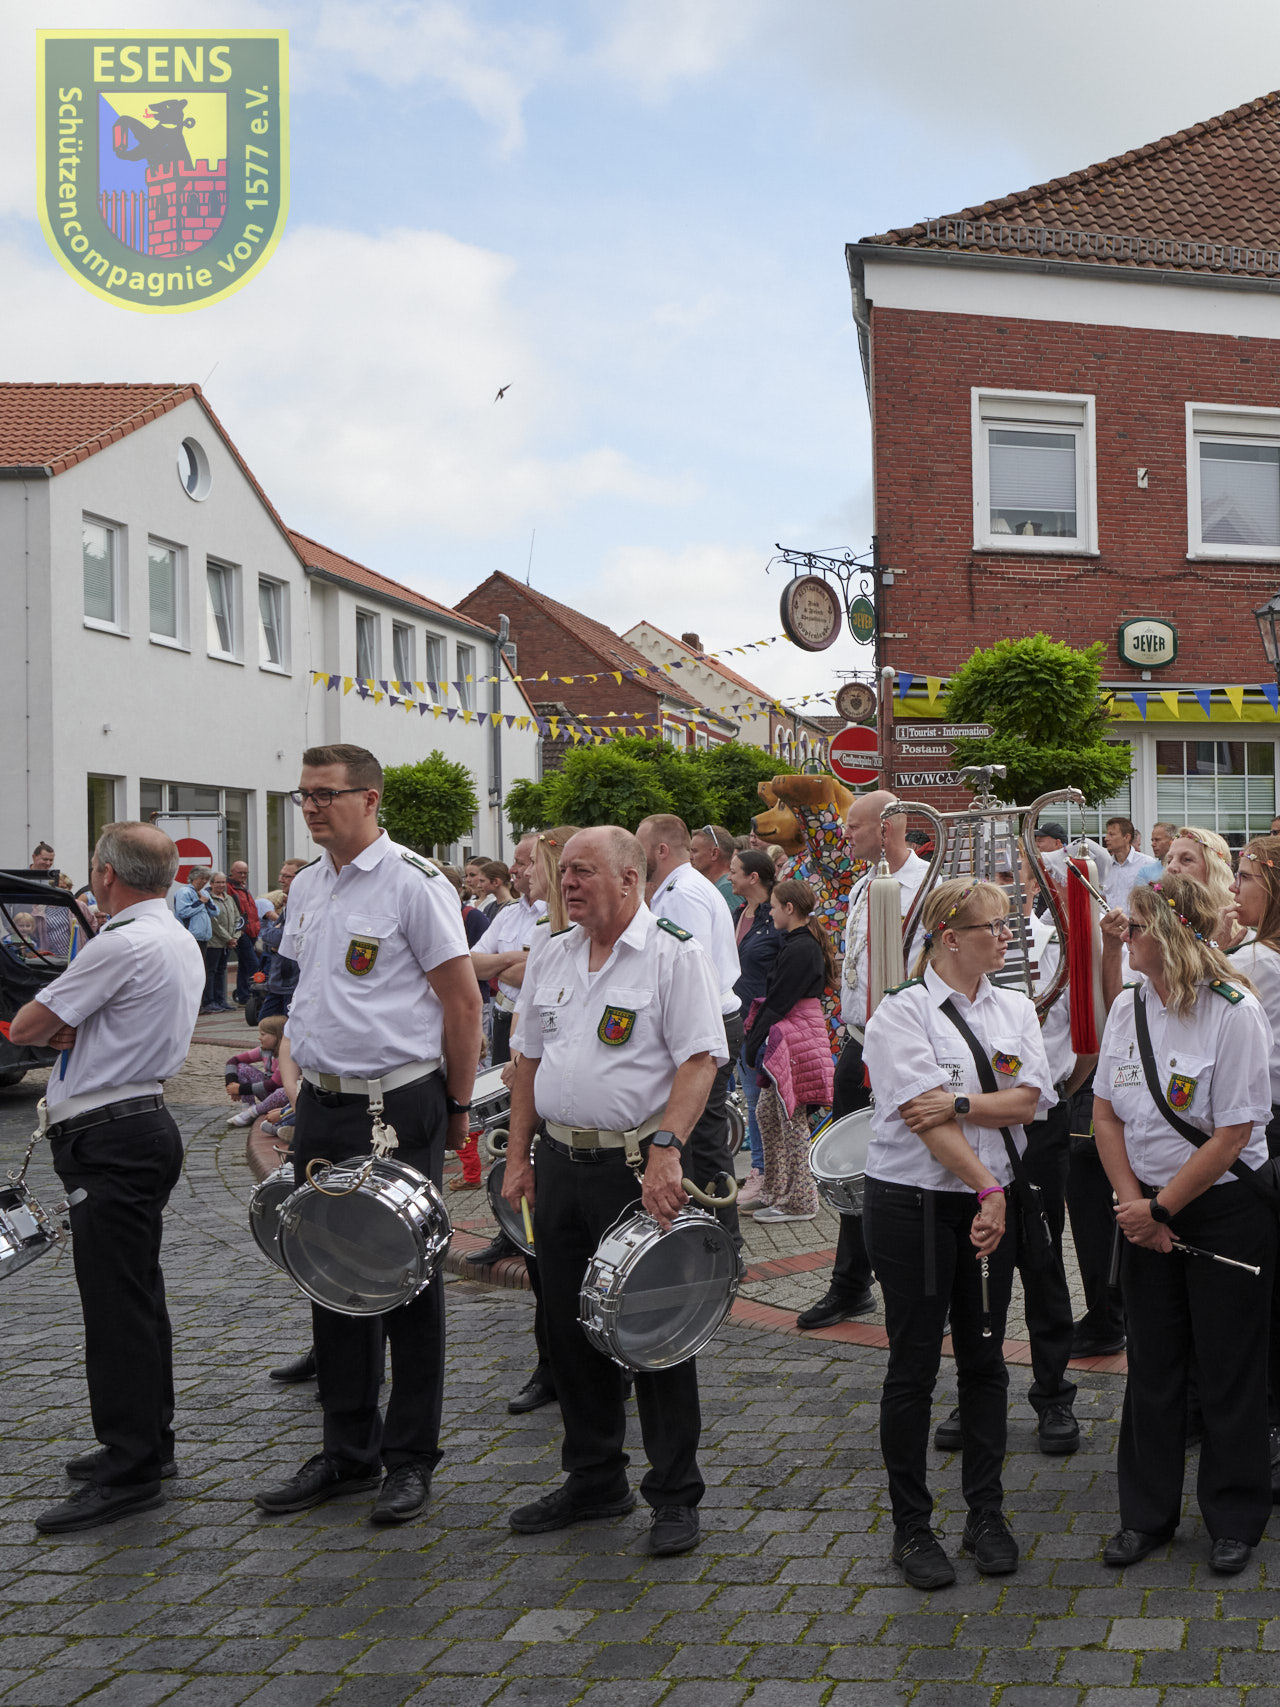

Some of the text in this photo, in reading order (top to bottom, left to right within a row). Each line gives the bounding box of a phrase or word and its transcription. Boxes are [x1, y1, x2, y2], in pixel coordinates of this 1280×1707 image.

[853, 612, 873, 630] JEVER
[1133, 634, 1166, 653] JEVER
[909, 727, 937, 737] Tourist
[943, 726, 989, 737] Information
[901, 744, 948, 754] Postamt
[900, 773, 945, 786] WC/WC
